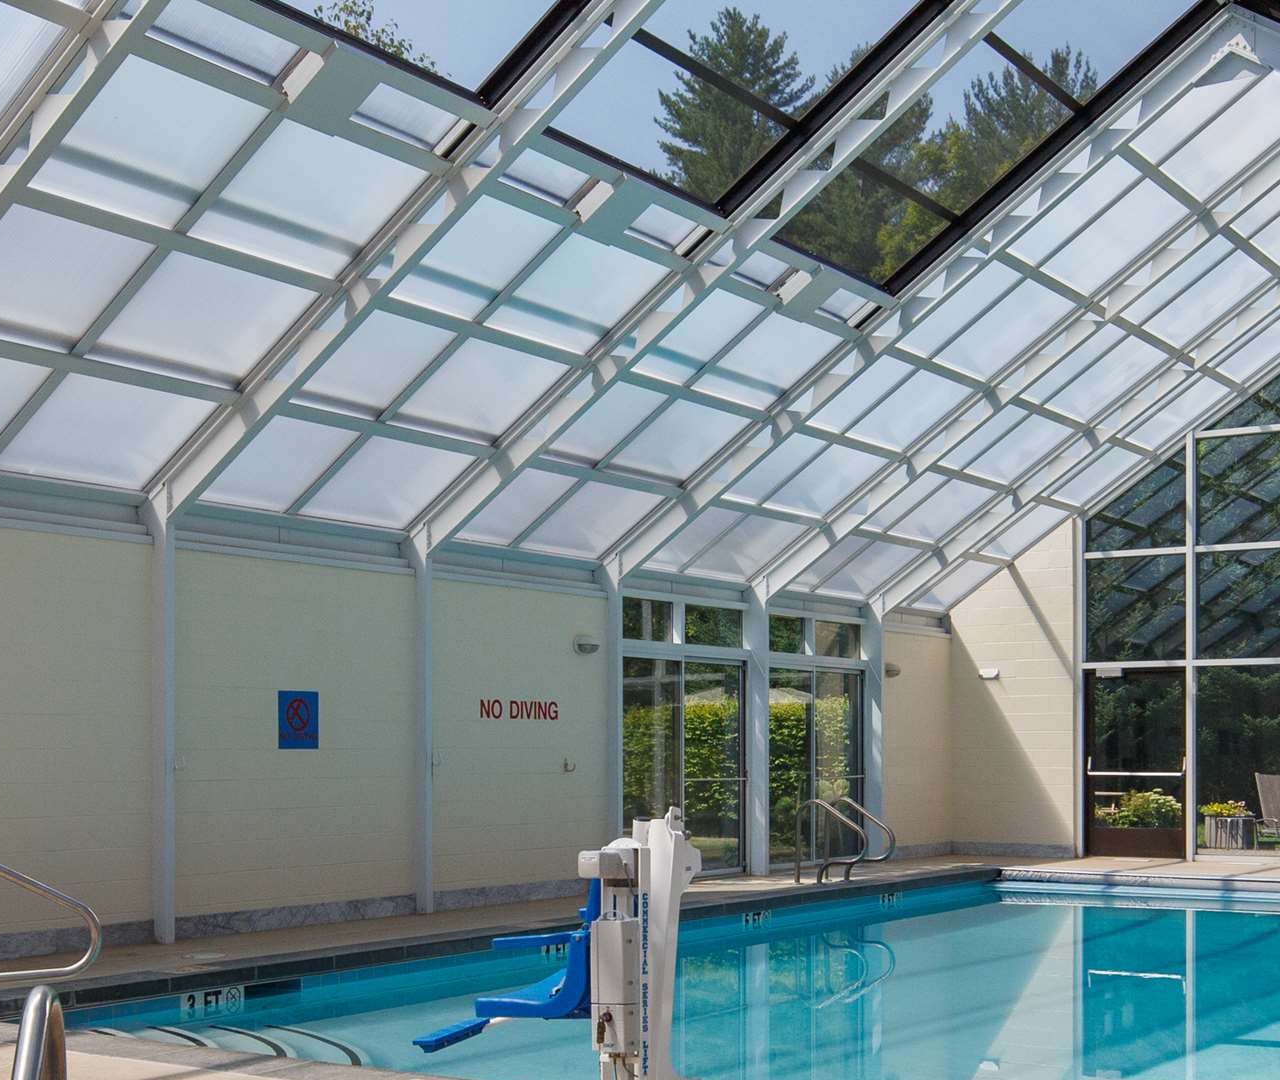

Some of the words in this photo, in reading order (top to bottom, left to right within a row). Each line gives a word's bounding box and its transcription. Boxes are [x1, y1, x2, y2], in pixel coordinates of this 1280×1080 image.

[480, 699, 503, 719] NO
[509, 700, 559, 720] DIVING
[204, 990, 222, 1007] FT
